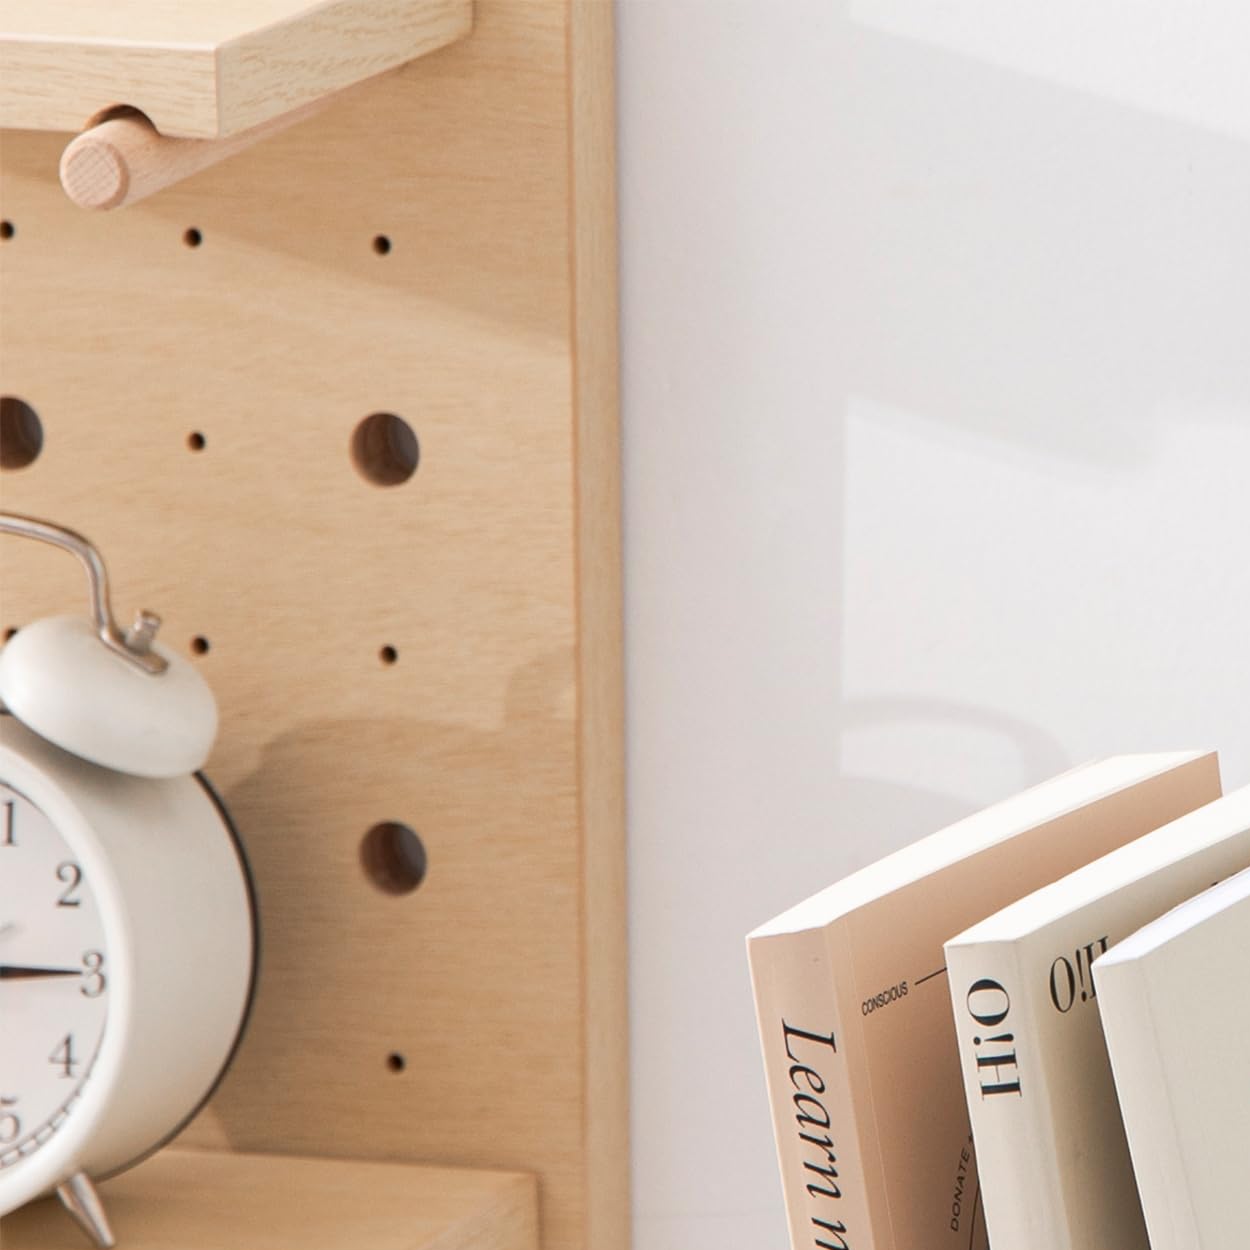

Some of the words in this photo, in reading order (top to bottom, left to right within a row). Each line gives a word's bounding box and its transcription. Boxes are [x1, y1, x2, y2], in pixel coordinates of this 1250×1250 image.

[4, 800, 17, 845] 1
[56, 862, 82, 906] 2
[81, 951, 106, 998] 3
[862, 981, 908, 1016] CONSCIOUS
[49, 1034, 79, 1079] 4
[966, 978, 1022, 1100] O!H
[782, 1018, 842, 1199] Learn
[950, 1147, 970, 1232] DONATE
